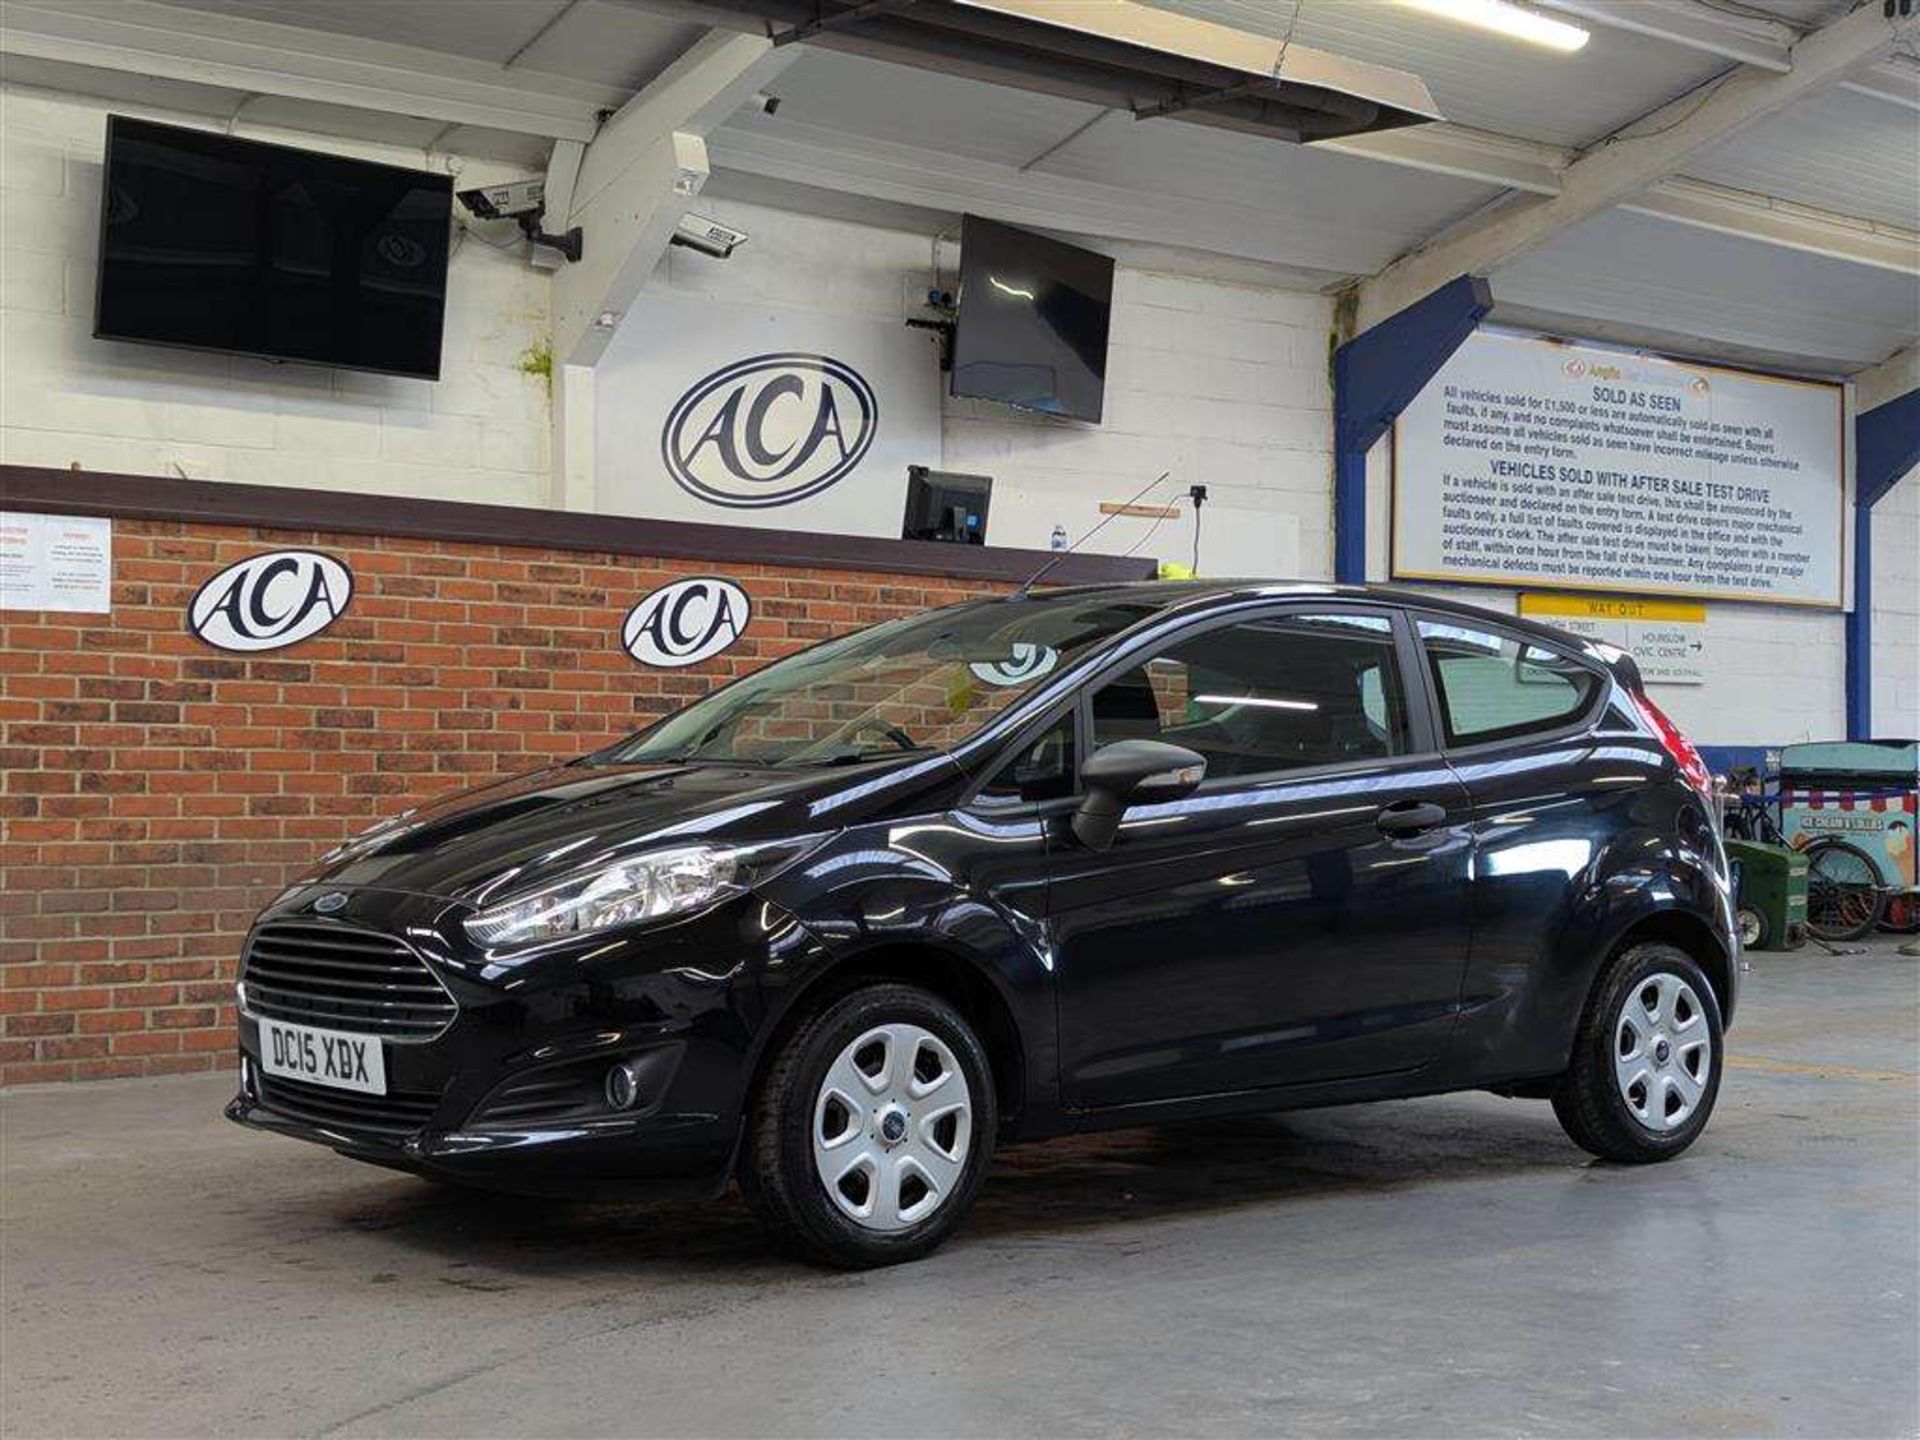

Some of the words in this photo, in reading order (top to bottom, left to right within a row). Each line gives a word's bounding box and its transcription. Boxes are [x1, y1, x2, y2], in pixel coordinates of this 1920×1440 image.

[1444, 386, 1457, 399] All
[1460, 389, 1501, 404] vehicles
[1504, 395, 1525, 407] sold
[1528, 397, 1543, 410] for
[1590, 405, 1609, 418] less
[1611, 410, 1625, 420] are
[1628, 411, 1687, 430] automatically
[1689, 419, 1708, 430] sold
[1723, 425, 1742, 435] seen
[1745, 425, 1762, 437] with
[1592, 387, 1626, 405] SOLD
[1630, 392, 1645, 407] AS
[1650, 395, 1681, 412] SEEN
[682, 373, 849, 482] ACA
[1443, 419, 1469, 431] must
[1472, 423, 1510, 436] assume
[1528, 428, 1567, 443] vehicles
[1571, 434, 1590, 446] sold
[1606, 439, 1628, 450] seen
[1631, 440, 1650, 453] have
[1653, 442, 1693, 458] incorrect
[1695, 448, 1729, 464] mileage
[1731, 453, 1757, 465] unless
[1760, 456, 1799, 470] otherwise
[1443, 434, 1487, 450] declared
[1490, 442, 1503, 451] on
[1506, 440, 1521, 453] the
[1524, 443, 1549, 459] entry
[1552, 445, 1577, 458] form.
[1513, 411, 1531, 423] and
[1534, 415, 1546, 425] no
[1549, 417, 1600, 432] complaints
[1603, 422, 1654, 439] whatsoever
[1657, 429, 1678, 442] shall
[1746, 440, 1774, 455] Buyers
[1462, 477, 1497, 490] vehicle
[1512, 482, 1533, 494] sold
[1536, 484, 1557, 496] with
[1573, 488, 1594, 500] after
[1597, 490, 1615, 502] sale
[1618, 492, 1634, 504] test
[1664, 496, 1681, 508] this
[1684, 499, 1704, 511] shall
[1720, 505, 1765, 517] announced
[1779, 508, 1792, 519] the
[1490, 460, 1555, 480] VEHICLES
[1560, 467, 1593, 484] SOLD
[1597, 471, 1627, 488] WITH
[1631, 475, 1669, 492] AFTER
[1672, 479, 1703, 496] SALE
[1706, 483, 1734, 499] TEST
[1737, 486, 1770, 503] DRIVE
[1443, 492, 1496, 506] auctioneer
[1500, 496, 1517, 508] and
[1521, 497, 1562, 512] declared
[1579, 503, 1593, 515] the
[1596, 505, 1619, 520] entry
[1622, 507, 1644, 519] form.
[1657, 510, 1673, 522] test
[1676, 512, 1698, 524] drive
[1701, 516, 1729, 527] covers
[1732, 519, 1754, 531] major
[1757, 520, 1802, 533] mechanical
[1443, 506, 1471, 520] faults
[1509, 512, 1524, 524] full
[1527, 514, 1542, 526] list
[1557, 516, 1583, 529] faults
[1586, 521, 1622, 533] covered
[1635, 523, 1678, 539] displayed
[1691, 528, 1704, 540] the
[1707, 530, 1731, 542] office
[1734, 533, 1749, 543] and
[1751, 534, 1770, 545] with
[1442, 523, 1503, 538] auctioneer's
[1507, 528, 1533, 540] clerk.
[1537, 530, 1554, 542] The
[1558, 532, 1578, 544] after
[1581, 534, 1599, 545] sale
[1603, 535, 1619, 547] test
[1622, 536, 1645, 549] drive
[1648, 540, 1669, 551] must
[1714, 544, 1749, 558] together
[1752, 547, 1768, 558] with
[1779, 550, 1810, 562] member
[1484, 541, 1514, 554] within
[1517, 546, 1535, 556] one
[1537, 545, 1559, 557] hour
[1562, 547, 1584, 559] from
[1586, 549, 1601, 561] the
[1603, 550, 1617, 562] fall
[1631, 552, 1645, 564] the
[1688, 557, 1703, 571] Any
[1707, 560, 1753, 573] complaints
[1765, 565, 1779, 577] any
[1782, 567, 1804, 578] major
[1443, 555, 1500, 569] mechanical
[1503, 558, 1539, 572] defects
[1542, 562, 1565, 573] must
[1582, 565, 1622, 578] reported
[1624, 567, 1652, 579] within
[1654, 572, 1669, 580] one
[1672, 570, 1692, 582] hour
[1695, 572, 1714, 584] from
[1717, 573, 1730, 585] the
[1733, 575, 1748, 586] test
[1750, 576, 1772, 588] drive.
[196, 557, 337, 640] ACA
[1588, 602, 1612, 614] WAY
[1619, 603, 1644, 616] OUT
[627, 583, 739, 657] ACA
[272, 1026, 317, 1074] DC15
